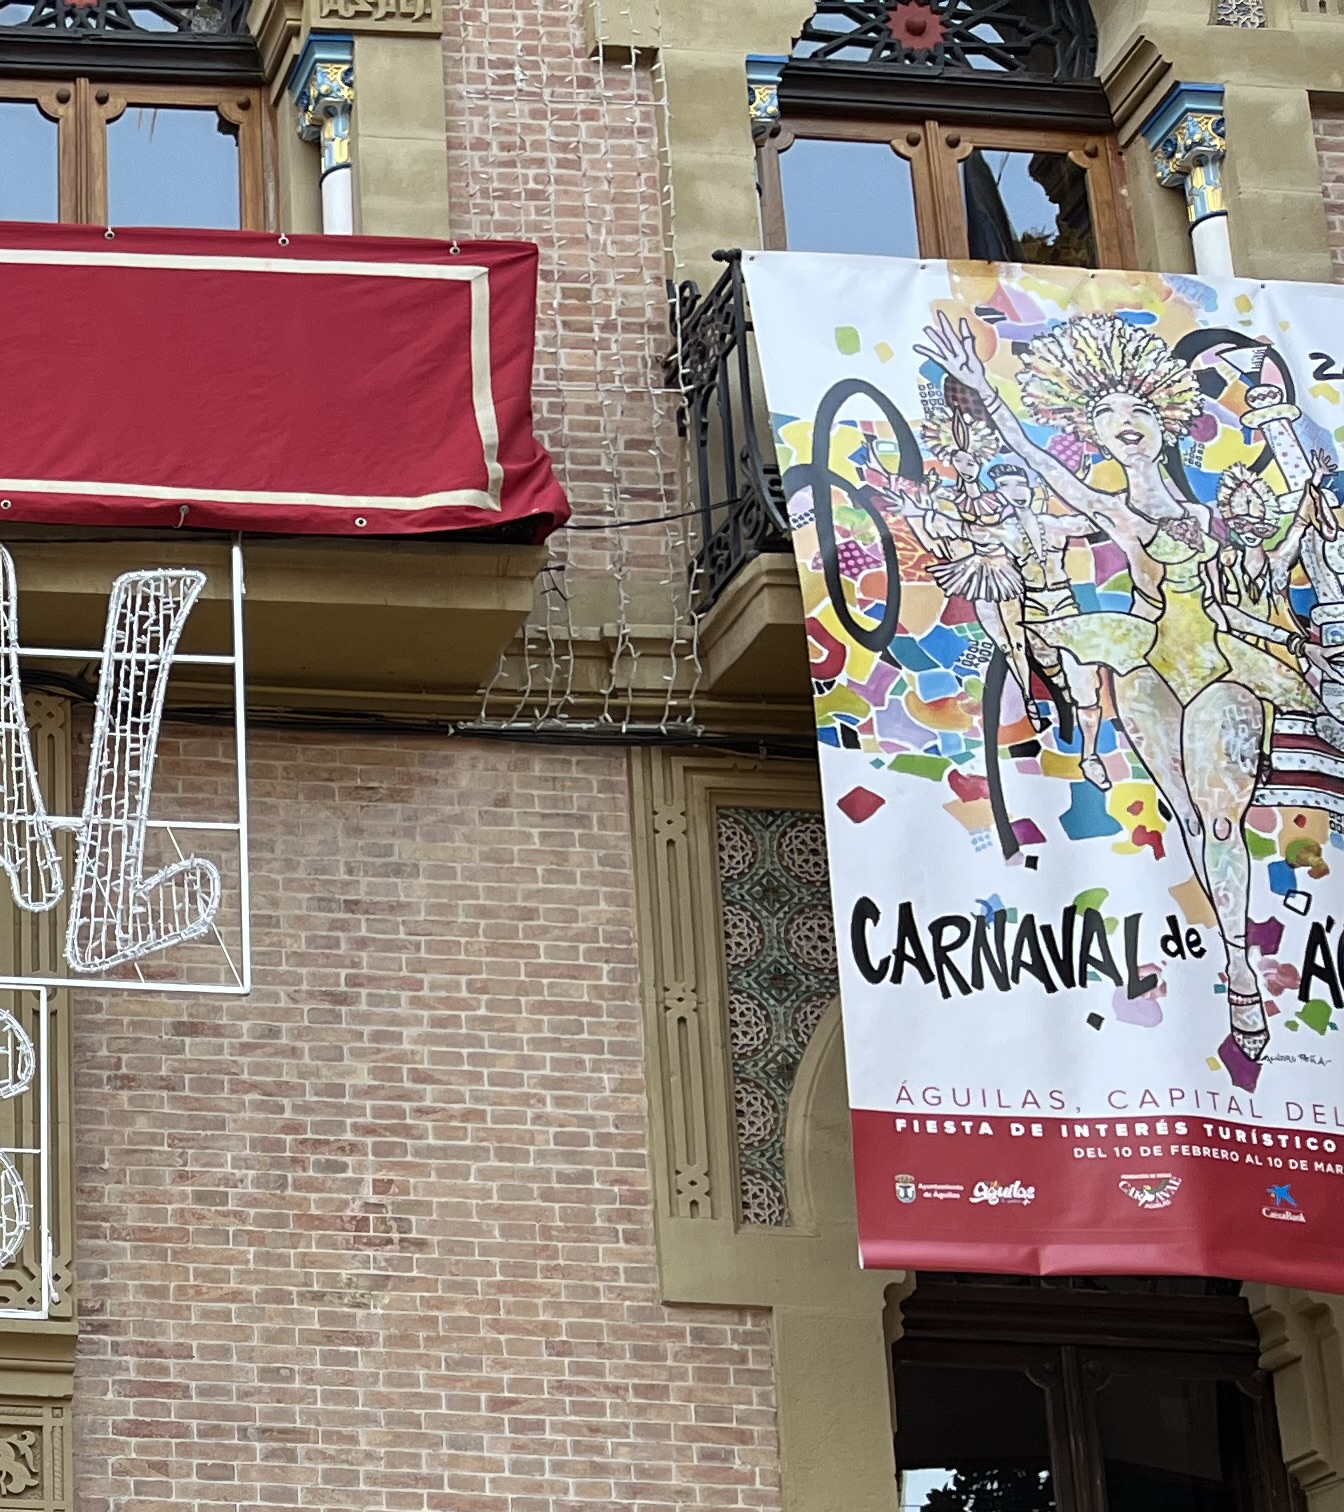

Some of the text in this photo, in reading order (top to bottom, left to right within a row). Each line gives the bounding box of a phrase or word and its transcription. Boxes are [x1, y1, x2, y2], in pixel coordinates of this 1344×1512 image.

[851, 896, 1158, 999] CARNAVAL
[1161, 914, 1207, 960] de
[895, 1079, 1344, 1127] ÁGUILAS, CAPITAL DEL
[895, 1118, 1337, 1153] FIESTA DE INTERÉS TURÍSTICO
[1073, 1147, 1107, 1159] DEL
[1114, 1146, 1132, 1158] 10
[1140, 1145, 1163, 1157] DE
[1170, 1145, 1239, 1162] FEBRERO
[1245, 1156, 1262, 1166] AL
[1267, 1157, 1283, 1169] 10
[1288, 1159, 1309, 1171] DE
[1262, 1207, 1306, 1223] CaixaBank
